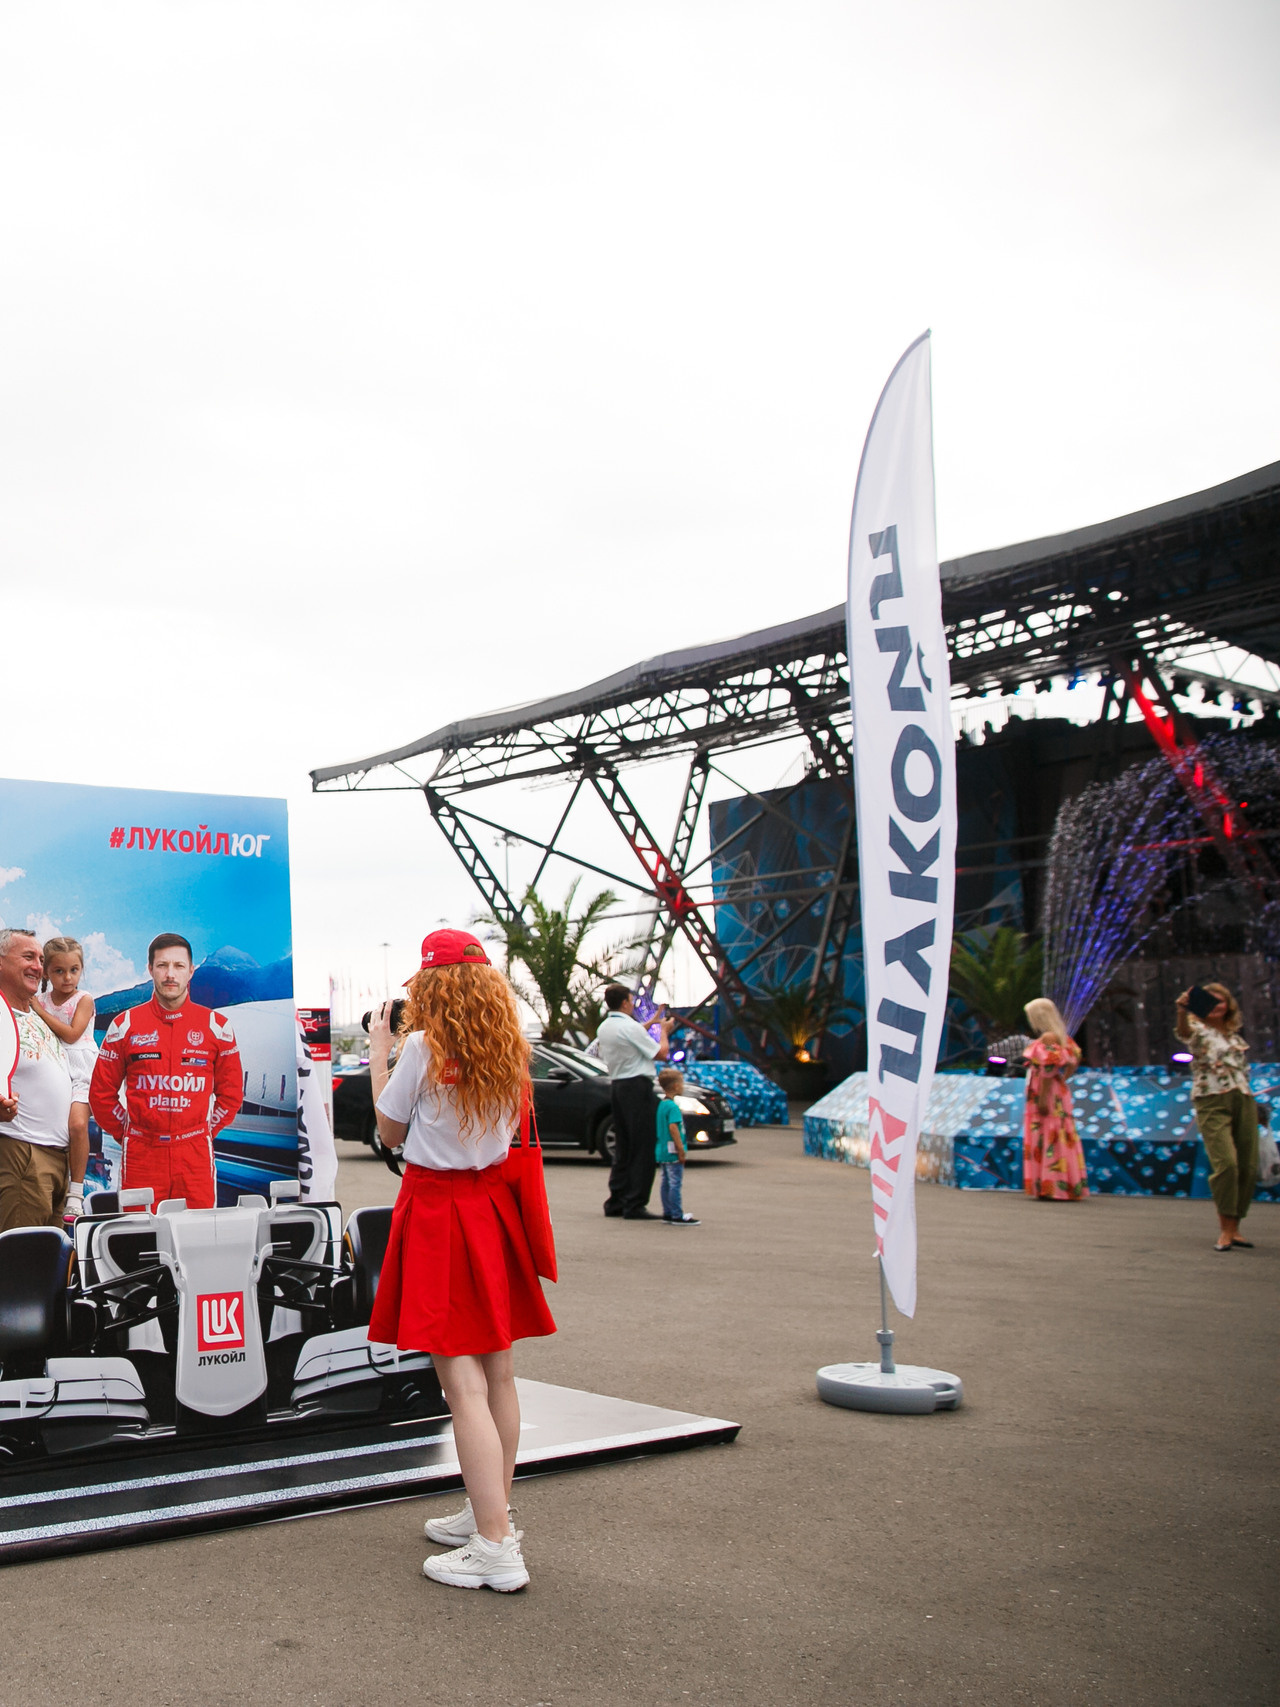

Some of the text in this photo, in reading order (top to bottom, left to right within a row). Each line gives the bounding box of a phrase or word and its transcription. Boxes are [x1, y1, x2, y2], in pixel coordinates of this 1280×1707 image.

[109, 824, 270, 858] #ЛУКОЙЛЮГ
[135, 1072, 206, 1092] ЛУКОЙЛ
[149, 1094, 191, 1109] plan b:
[198, 1351, 246, 1367] ЛУКОЙЛ
